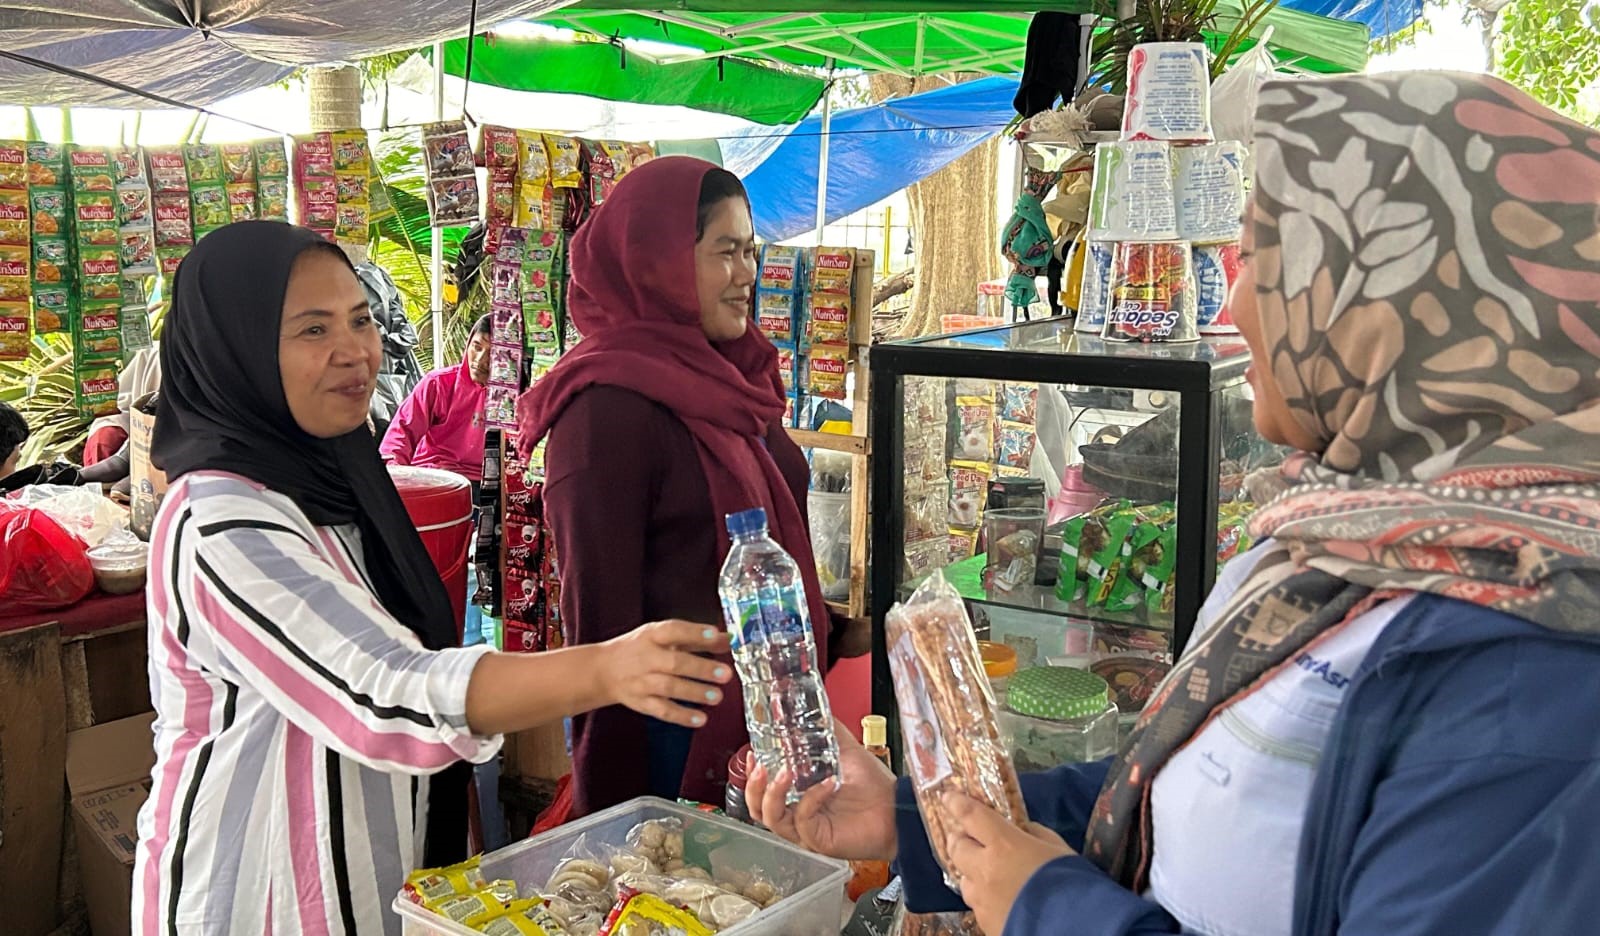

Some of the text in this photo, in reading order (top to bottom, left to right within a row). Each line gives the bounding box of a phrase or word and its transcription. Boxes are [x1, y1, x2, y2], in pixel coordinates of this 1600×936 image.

[72, 152, 107, 165] NutriSari
[80, 206, 113, 220] NutriSari
[84, 261, 117, 275] NutriSari
[818, 255, 848, 268] NutriSari
[763, 267, 793, 279] NutriSari
[815, 307, 845, 321] NutriSari
[1108, 307, 1179, 328] Sedaap
[0, 319, 26, 331] riSari
[760, 319, 789, 331] NutriSari
[812, 359, 843, 373] NutriSari
[82, 379, 116, 393] NutriSari
